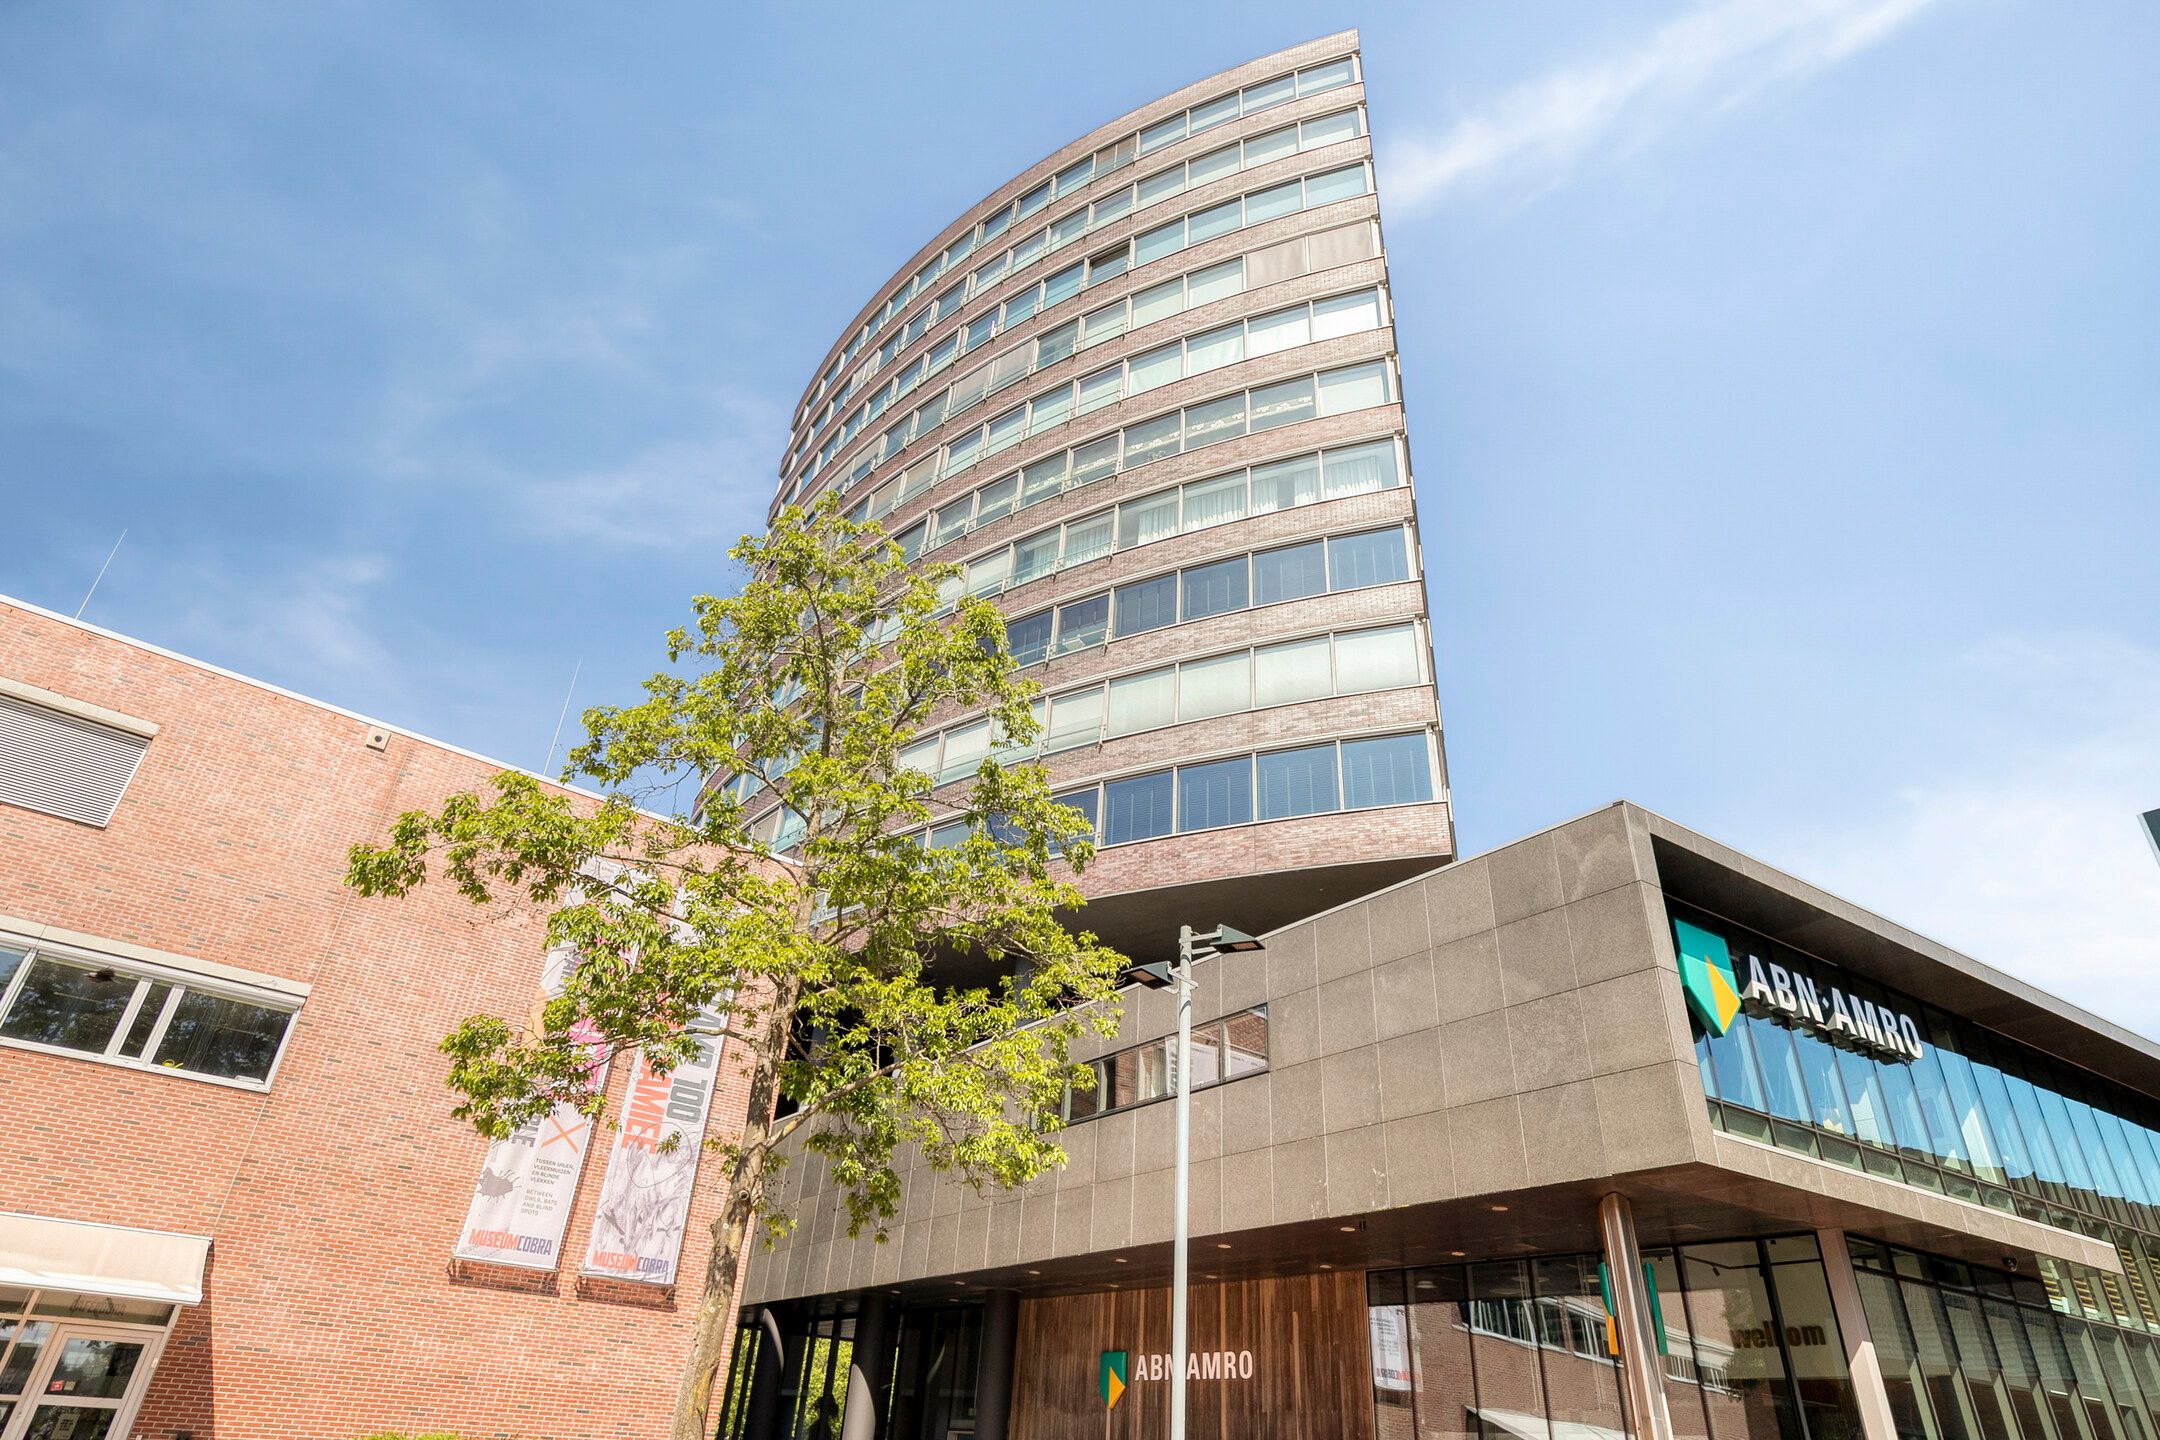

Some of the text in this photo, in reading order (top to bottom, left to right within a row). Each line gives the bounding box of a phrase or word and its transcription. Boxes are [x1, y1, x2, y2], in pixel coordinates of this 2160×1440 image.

[665, 1077, 709, 1124] 100
[535, 1158, 557, 1166] TUSSEN
[533, 1164, 571, 1175] VLEERMUIZEN
[540, 1171, 561, 1180] BLINDE
[530, 1176, 555, 1185] VLEKKEN
[526, 1189, 553, 1198] BETWEEN
[520, 1208, 539, 1216] SPOTS
[1730, 1320, 1827, 1349] welom
[1186, 1350, 1253, 1380] AMRO
